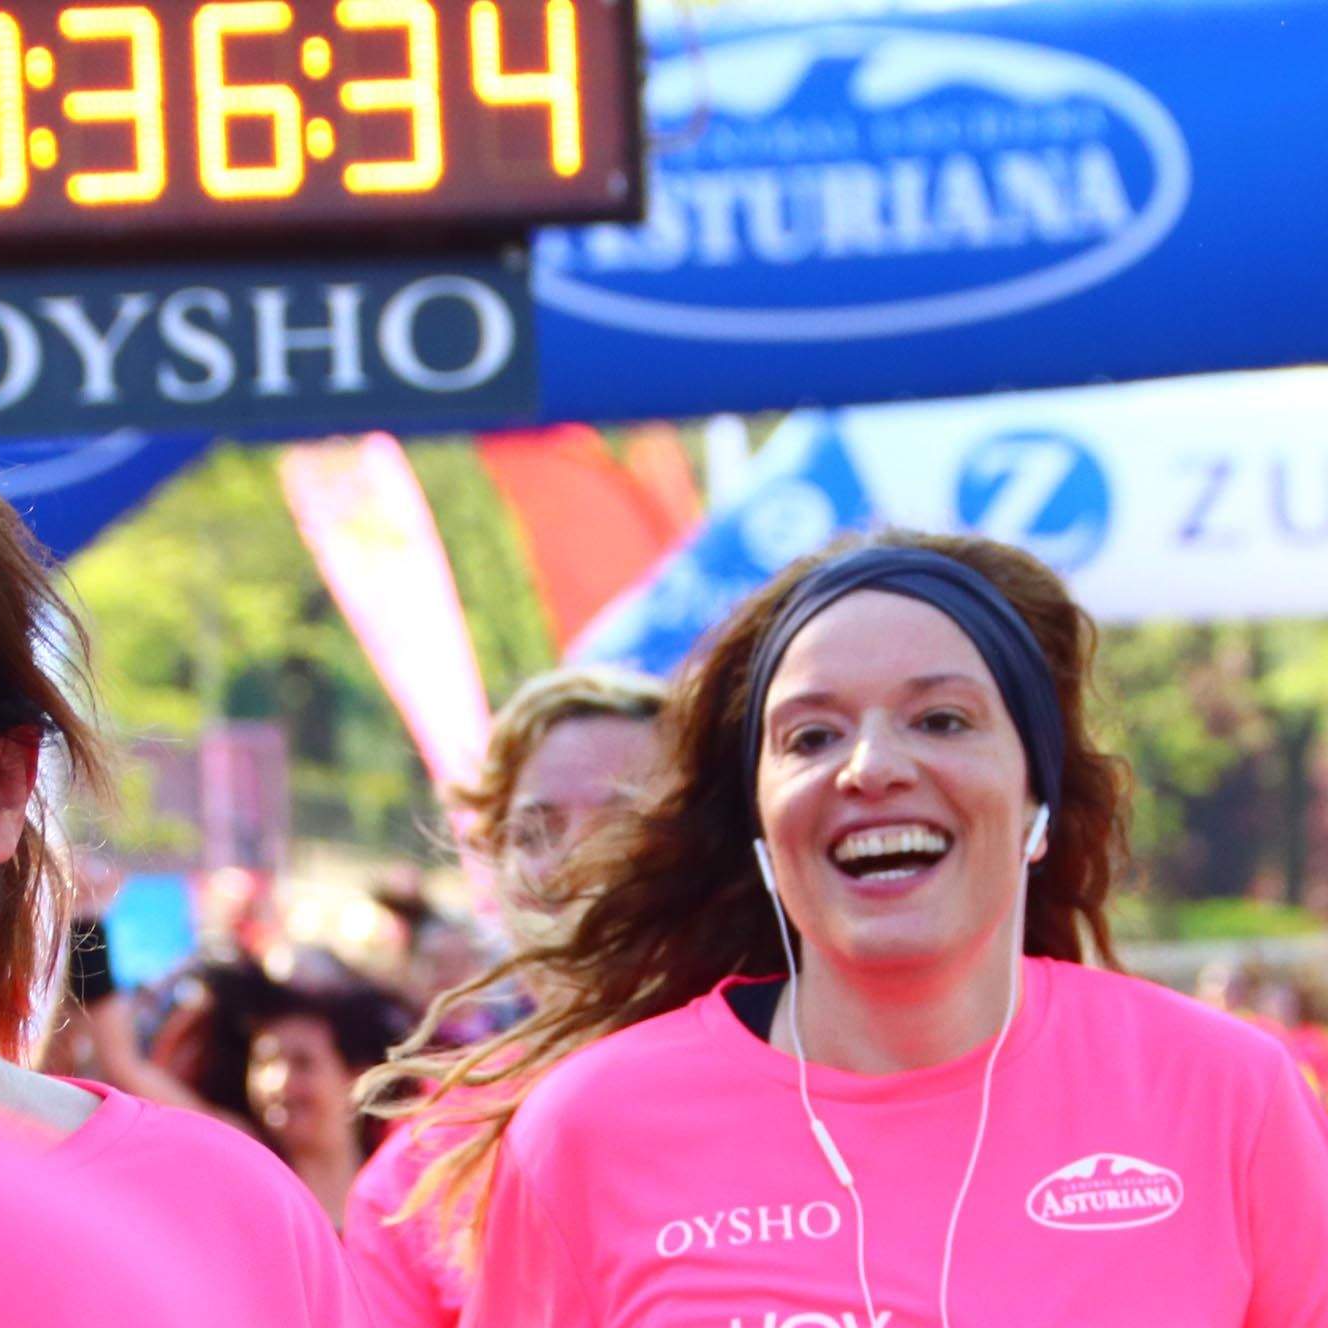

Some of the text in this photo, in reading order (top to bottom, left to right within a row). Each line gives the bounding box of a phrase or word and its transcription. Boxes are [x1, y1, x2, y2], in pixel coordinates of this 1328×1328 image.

[536, 140, 1130, 272] STURIANA
[655, 1200, 841, 1258] OYSHO
[1040, 1184, 1174, 1219] ASTURIANA
